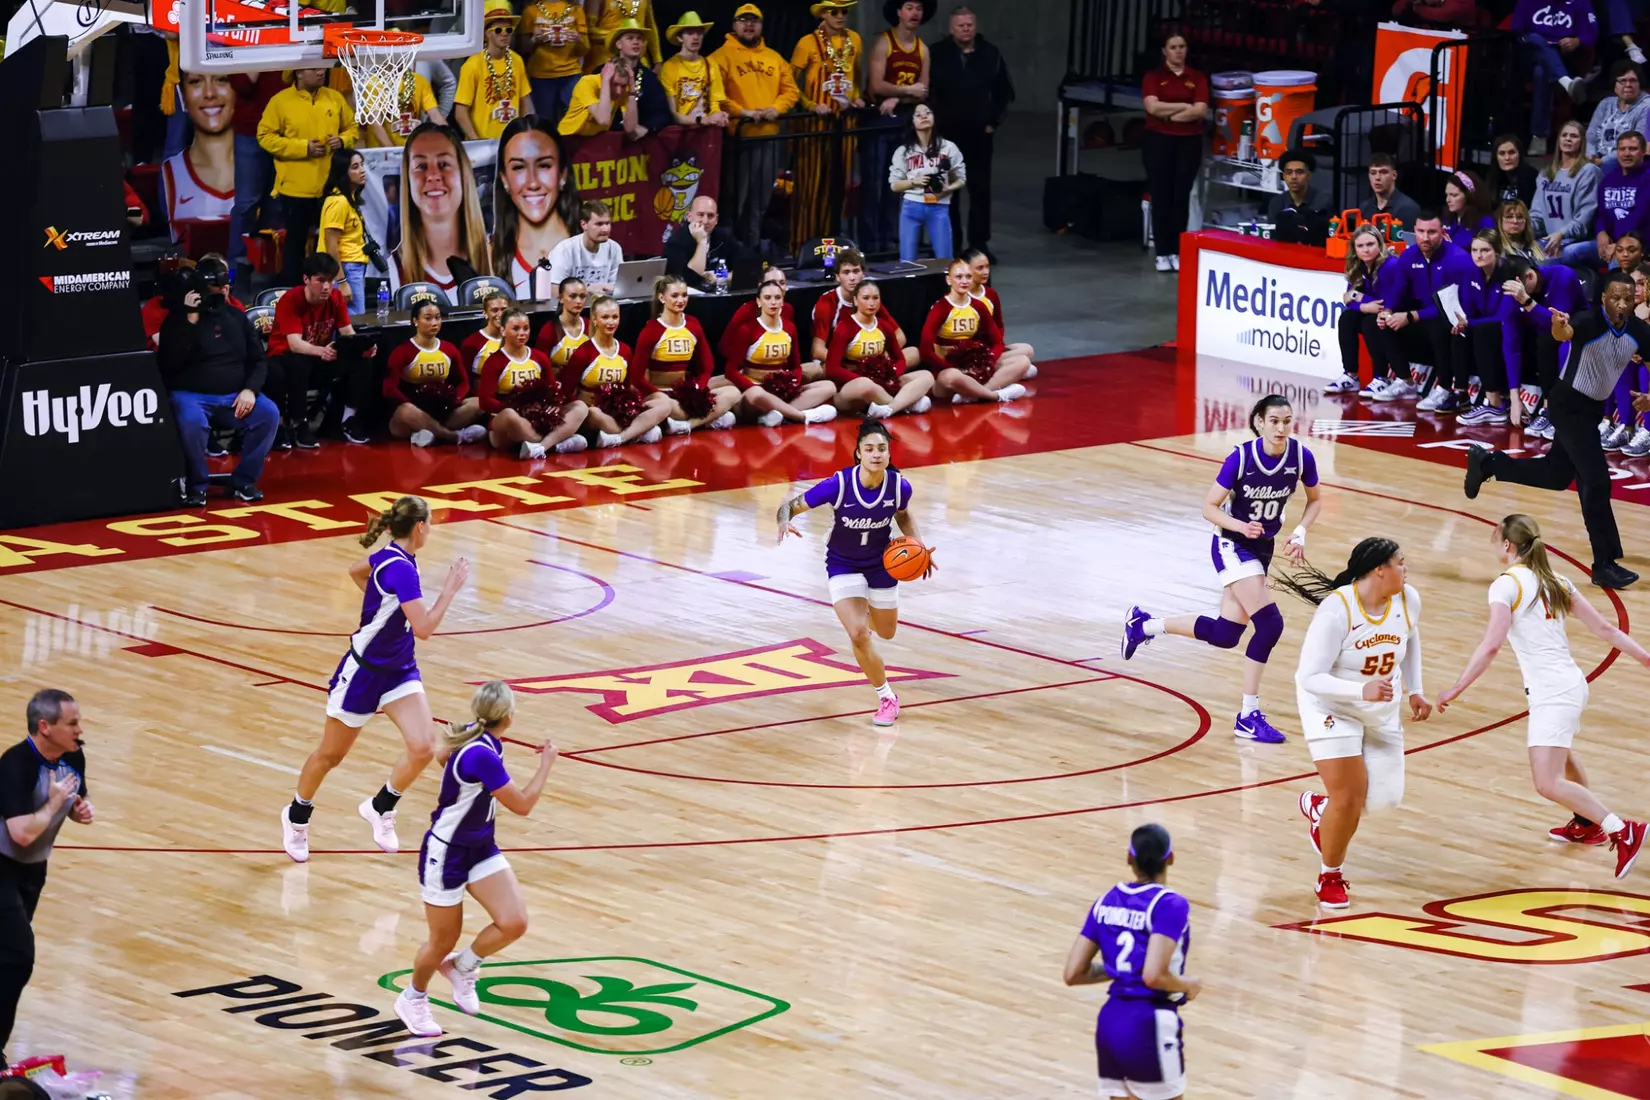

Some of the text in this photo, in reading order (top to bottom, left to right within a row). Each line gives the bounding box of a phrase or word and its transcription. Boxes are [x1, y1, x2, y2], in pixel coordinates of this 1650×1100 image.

[1532, 5, 1572, 28] Cats
[206, 51, 233, 60] SPALDING
[736, 60, 775, 77] AMES
[1256, 96, 1273, 122] G
[572, 154, 650, 190] ILTON
[1547, 194, 1564, 220] 11
[66, 230, 121, 242] XTREAM
[53, 270, 130, 285] MIDAMERICAN
[53, 280, 130, 294] ENERGY COMPANY
[254, 316, 275, 329] STAT
[953, 318, 975, 332] ISU
[667, 339, 691, 353] ISU
[862, 341, 883, 356] ISU
[1252, 326, 1320, 358] mobile
[765, 343, 789, 358] ISU
[419, 362, 445, 377] ISU
[598, 368, 622, 382] ISU
[511, 370, 536, 386] ISU
[22, 383, 158, 443] HyVee
[1242, 484, 1291, 499] Wildcats
[106, 463, 707, 547] STATE
[1248, 500, 1280, 521] 30
[841, 516, 890, 530] Wildcats
[860, 531, 870, 546] 1
[1354, 633, 1401, 650] Cyclones
[1360, 651, 1395, 676] 55
[1116, 930, 1136, 972] 2
[171, 974, 593, 1100] PIONEER
